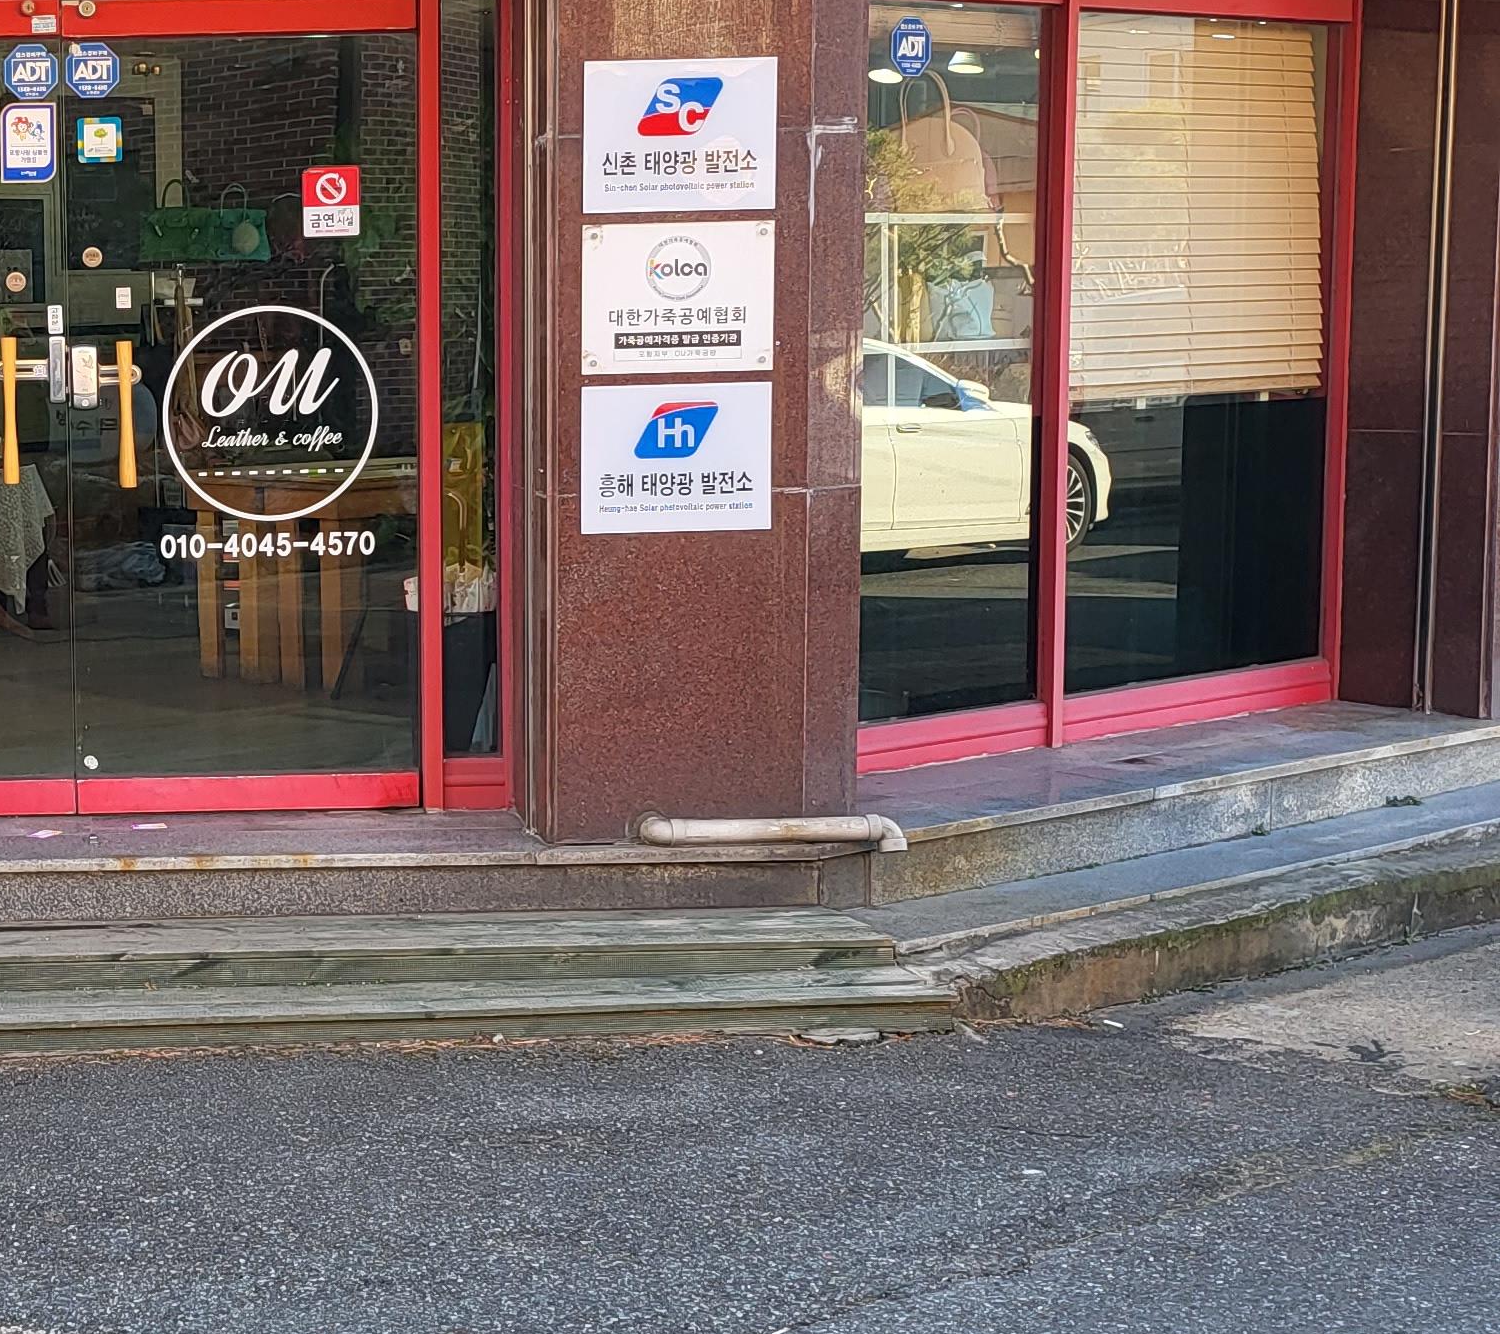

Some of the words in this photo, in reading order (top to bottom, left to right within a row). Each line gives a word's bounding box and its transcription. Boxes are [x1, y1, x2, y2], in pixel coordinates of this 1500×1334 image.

[897, 35, 925, 57] ADT
[12, 61, 49, 82] ADT
[74, 60, 111, 80] ADT
[654, 82, 705, 133] SC
[602, 151, 637, 176] 신촌
[644, 149, 698, 175] 태양광
[704, 148, 758, 174] 발전소
[639, 182, 659, 192] Solar
[706, 181, 728, 191] power
[729, 180, 755, 189] station
[309, 213, 335, 229] 금연
[608, 305, 748, 328] 대한가죽공예협회
[618, 334, 680, 346] 가죽공예자격증
[682, 334, 700, 345] 발급
[702, 332, 738, 344] 인증기관
[201, 425, 270, 448] Leather
[275, 431, 288, 445] &
[292, 425, 343, 452] coffee
[657, 417, 696, 449] Hh
[598, 472, 634, 498] 흥해
[641, 471, 694, 497] 태양광
[701, 470, 754, 496] 발전소
[639, 503, 659, 512] Solar
[705, 502, 727, 511] power
[728, 501, 754, 510] station
[160, 530, 376, 559] 010-4045-4570
